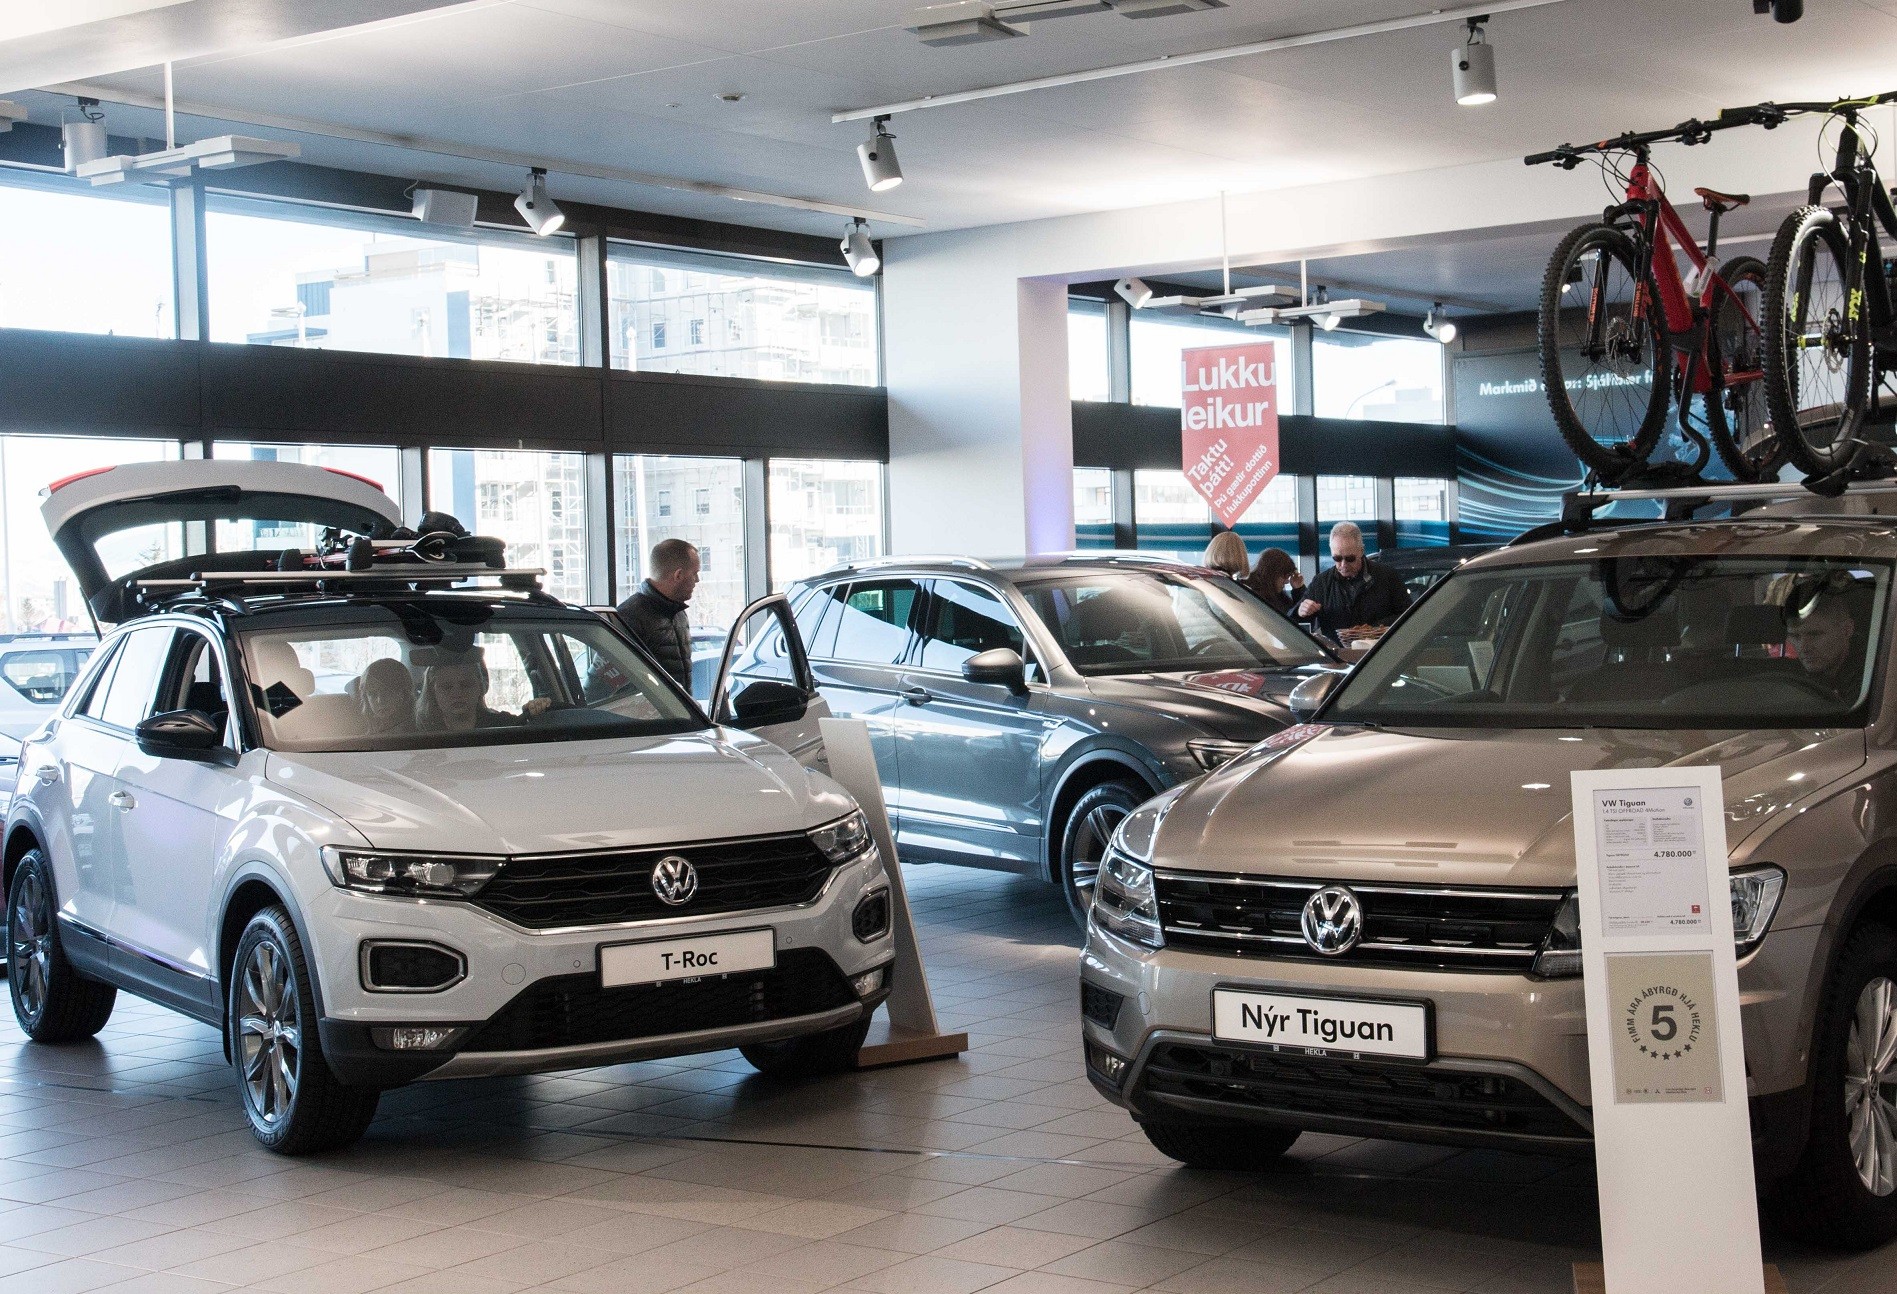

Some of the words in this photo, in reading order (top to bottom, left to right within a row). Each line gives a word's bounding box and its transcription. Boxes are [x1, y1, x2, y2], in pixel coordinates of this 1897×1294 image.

[1181, 356, 1276, 392] Lukku
[1479, 379, 1538, 396] Markmið
[1181, 396, 1269, 430] leikur
[1187, 438, 1228, 481] Taktu
[1199, 454, 1235, 498] þátt!
[1214, 493, 1227, 508] Þú
[1226, 470, 1246, 497] gætir
[1245, 444, 1267, 472] dottið
[1226, 460, 1273, 514] lukkupottinn
[1619, 800, 1646, 808] Tiguan
[1653, 850, 1692, 858] 4.780.000
[661, 950, 718, 970] T-Roc
[683, 977, 702, 985] HEKLA
[1641, 985, 1678, 999] ÁBYRGÐ
[1626, 997, 1643, 1016] ÁRA
[1679, 993, 1697, 1011] HJÁ
[1241, 1002, 1290, 1038] Nýr
[1296, 1008, 1394, 1044] Tiguan
[1626, 1018, 1641, 1043] FIMM
[1650, 1005, 1678, 1041] 5
[1688, 1012, 1701, 1043] HEKLU
[1304, 1047, 1327, 1057] HEKLA
